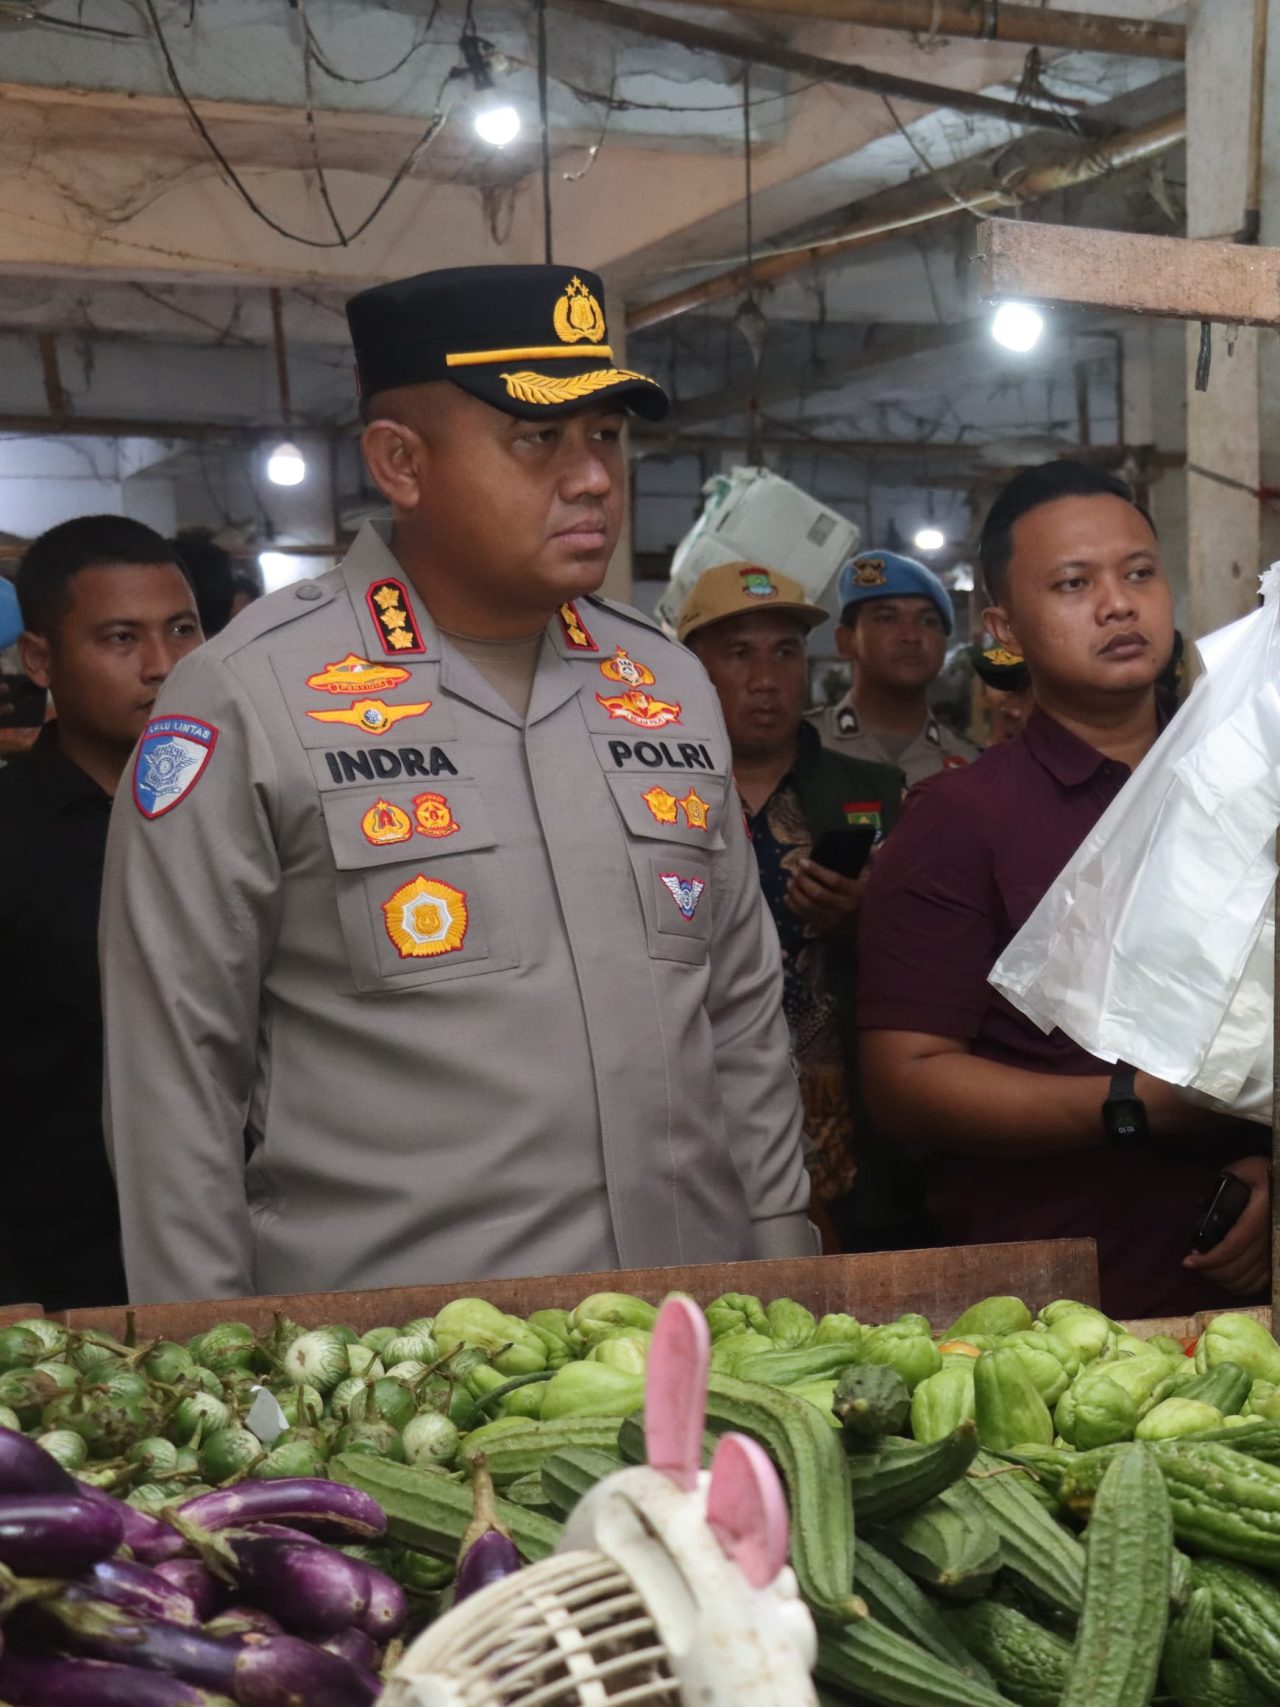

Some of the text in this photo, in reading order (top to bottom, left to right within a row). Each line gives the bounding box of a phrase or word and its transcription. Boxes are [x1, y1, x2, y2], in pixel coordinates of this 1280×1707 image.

[173, 721, 210, 739] LINTAS
[325, 746, 458, 784] INDRA
[608, 740, 715, 770] POLRI
